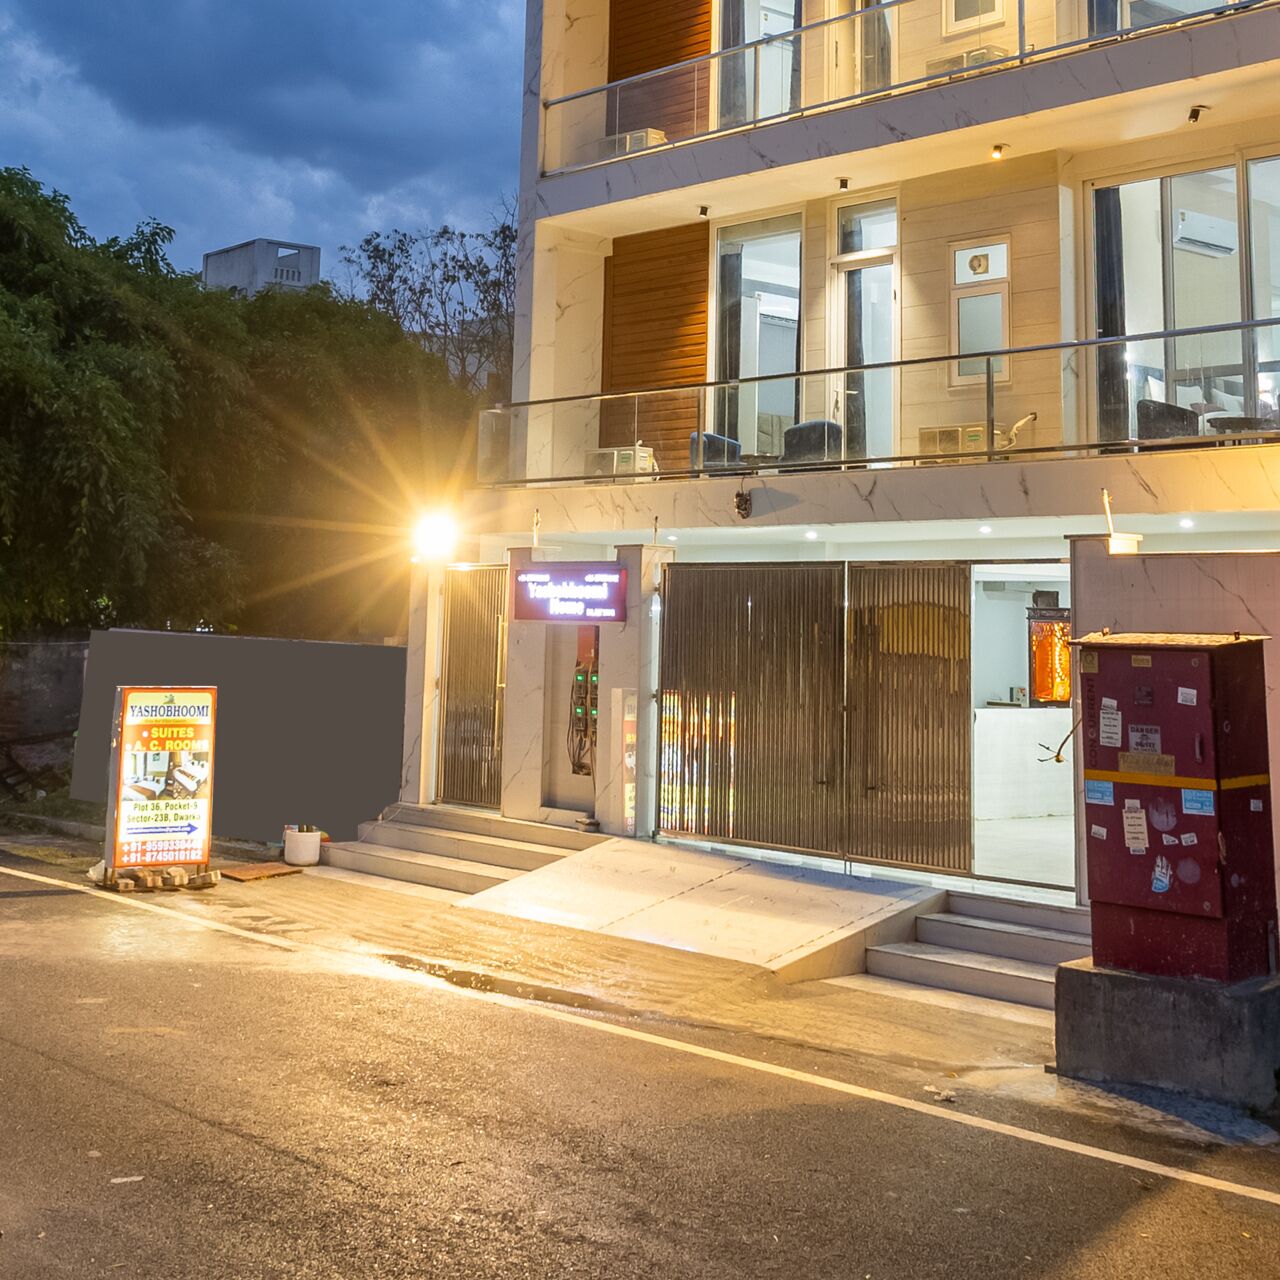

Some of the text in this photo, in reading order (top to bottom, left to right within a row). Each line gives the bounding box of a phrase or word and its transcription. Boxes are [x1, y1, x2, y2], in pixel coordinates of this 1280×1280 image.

[130, 705, 209, 717] YASHOBHOOMI
[151, 727, 194, 738] SUITES
[165, 739, 209, 751] ROOMS
[133, 802, 148, 812] Plot
[164, 801, 198, 811] Pocket-9
